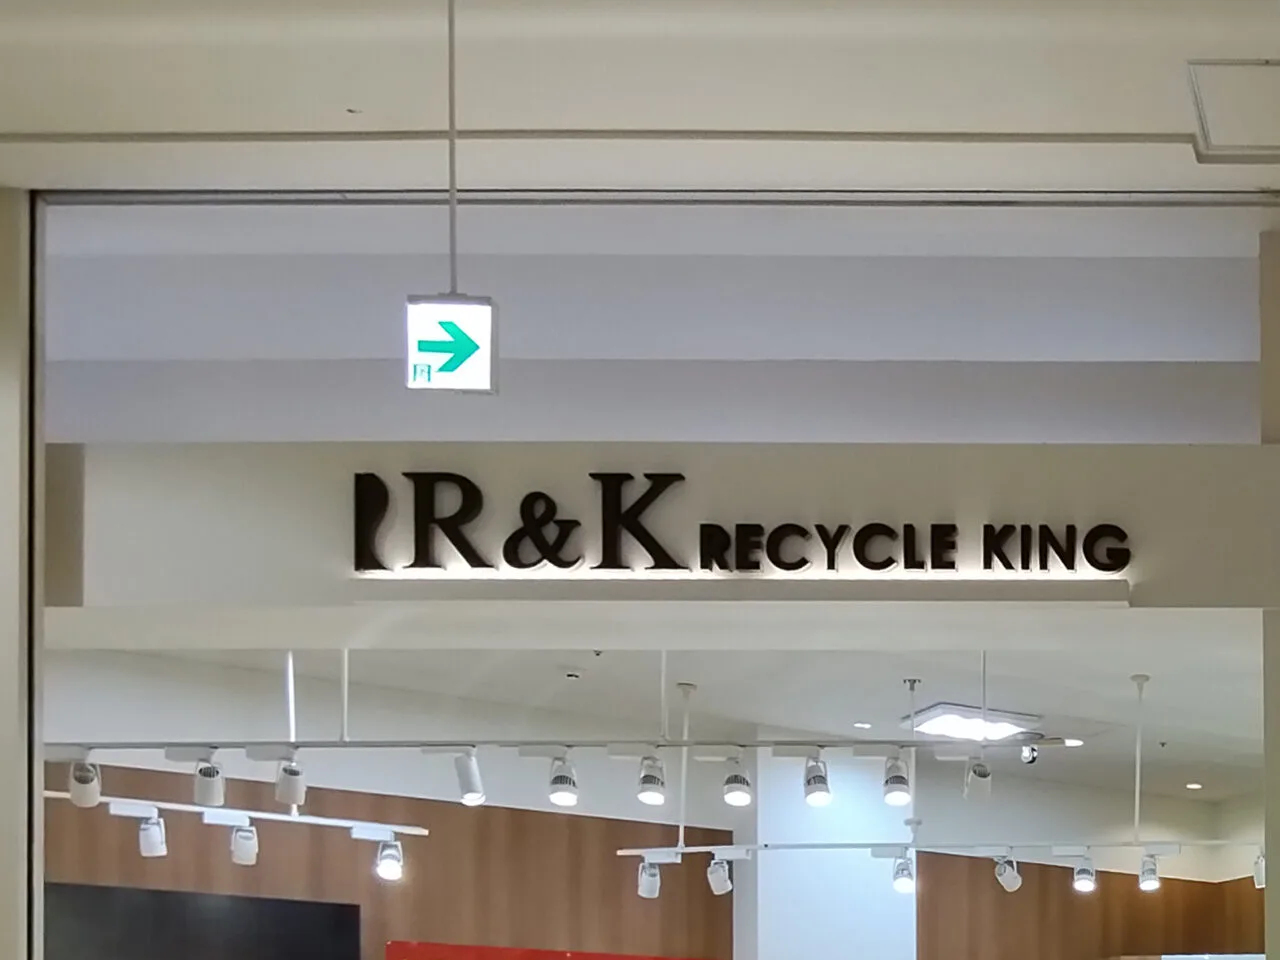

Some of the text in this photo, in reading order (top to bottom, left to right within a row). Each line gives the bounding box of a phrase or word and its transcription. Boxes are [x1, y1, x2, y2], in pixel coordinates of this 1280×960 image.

[403, 472, 1132, 573] R&K RECYCLE KING
